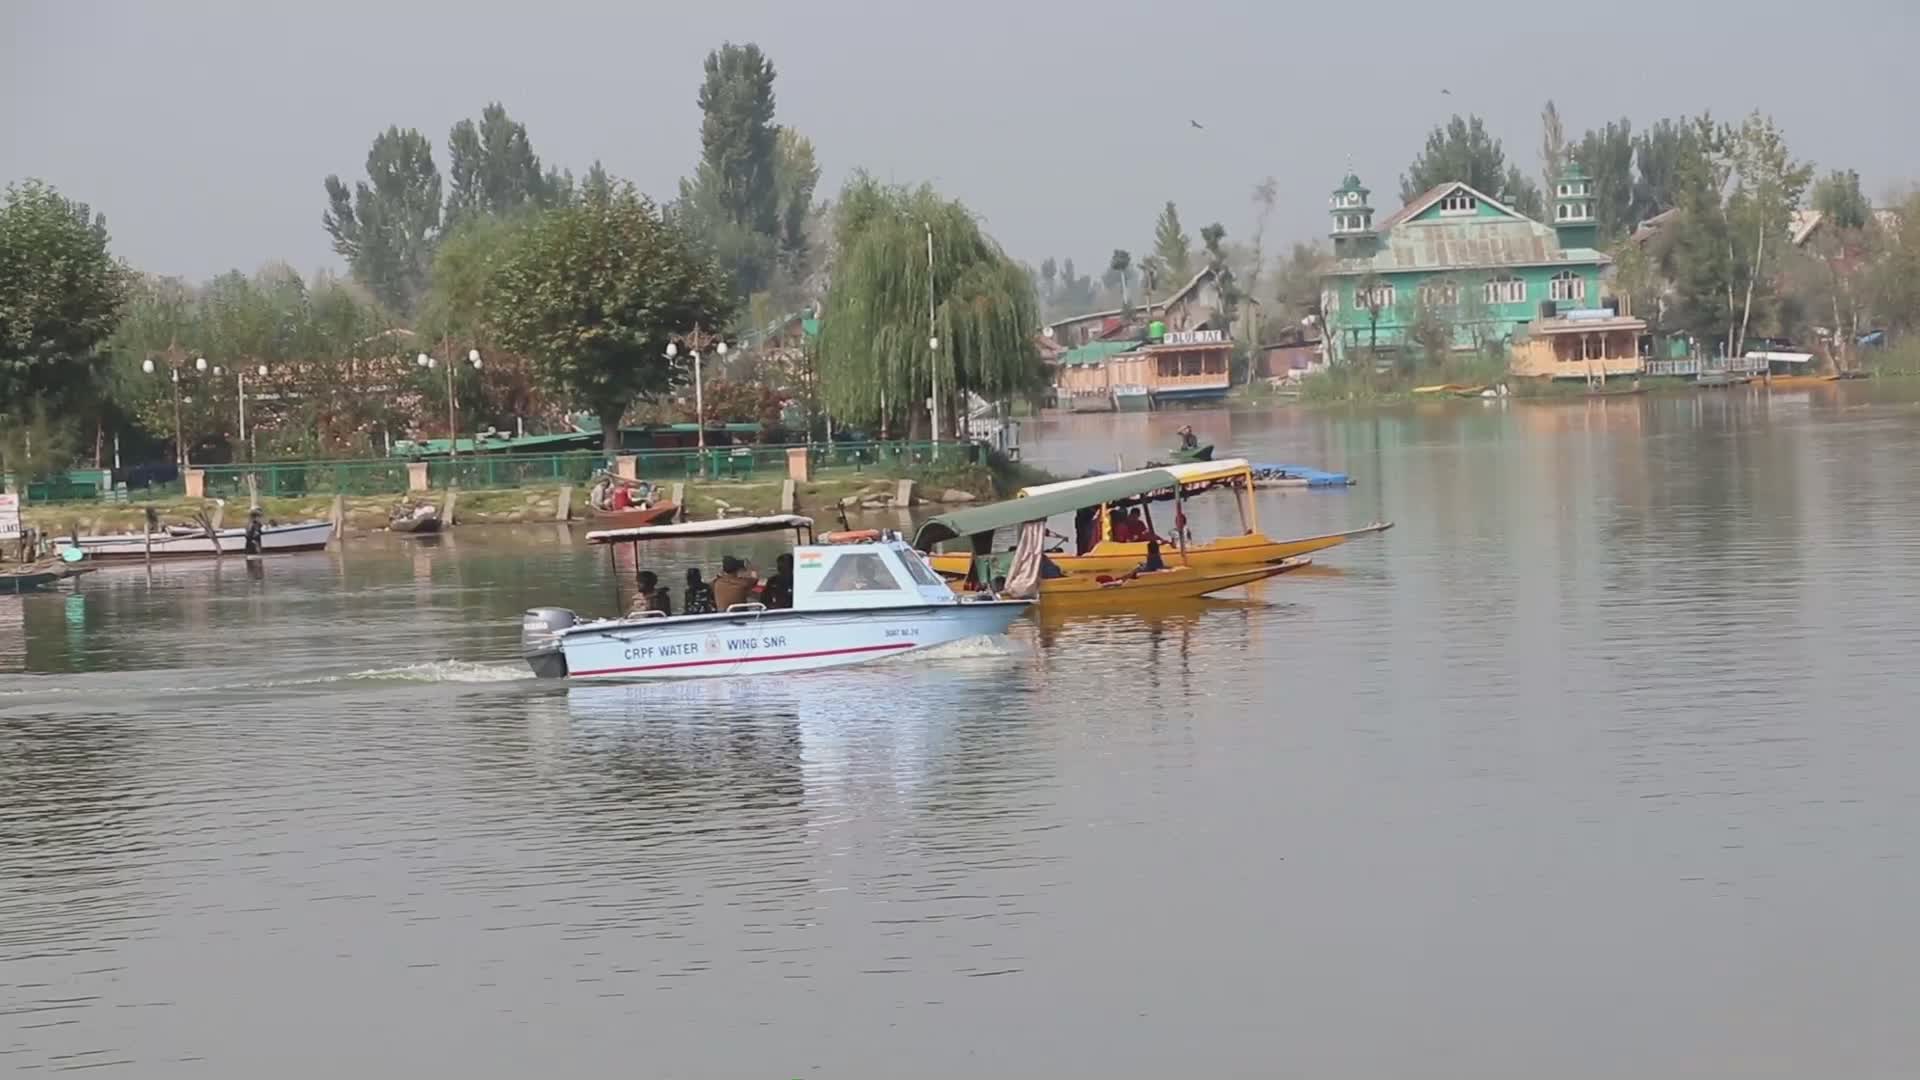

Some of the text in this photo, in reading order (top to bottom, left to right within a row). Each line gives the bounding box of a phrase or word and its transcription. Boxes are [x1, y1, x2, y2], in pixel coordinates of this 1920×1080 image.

[1172, 332, 1196, 343] BLUE
[624, 635, 787, 660] CRPF WATER WING SNR
